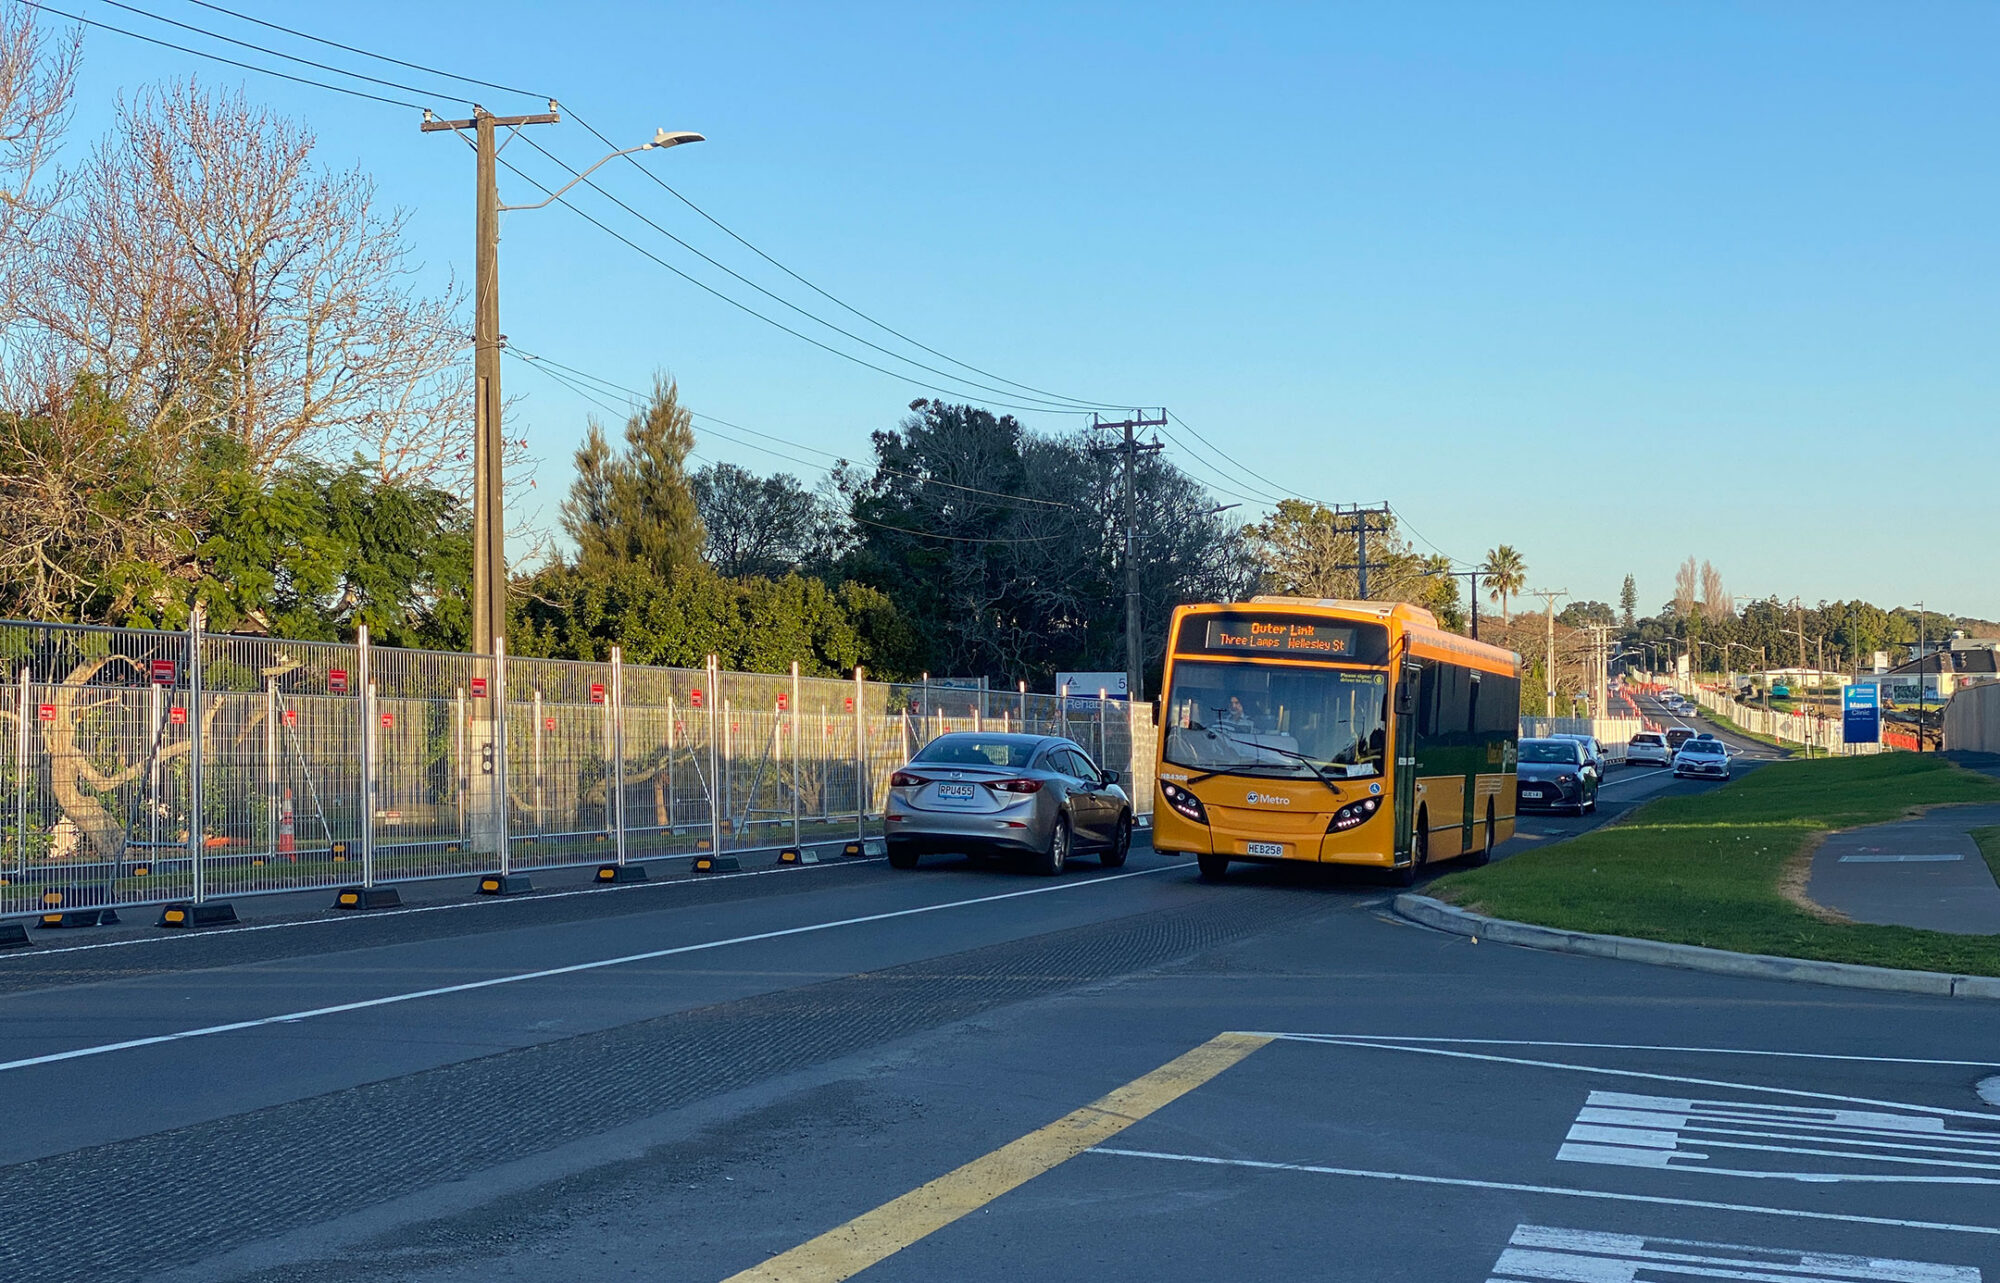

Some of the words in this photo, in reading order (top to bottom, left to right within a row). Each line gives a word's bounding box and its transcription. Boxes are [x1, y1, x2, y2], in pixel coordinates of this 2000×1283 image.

[1251, 622, 1287, 634] Outer
[1290, 624, 1314, 636] Link
[1220, 633, 1247, 645] Three
[1250, 635, 1280, 647] Lamps
[1332, 639, 1345, 652] St
[940, 785, 972, 796] RPU455
[1260, 793, 1290, 805] Metro
[1248, 843, 1283, 855] HEB258
